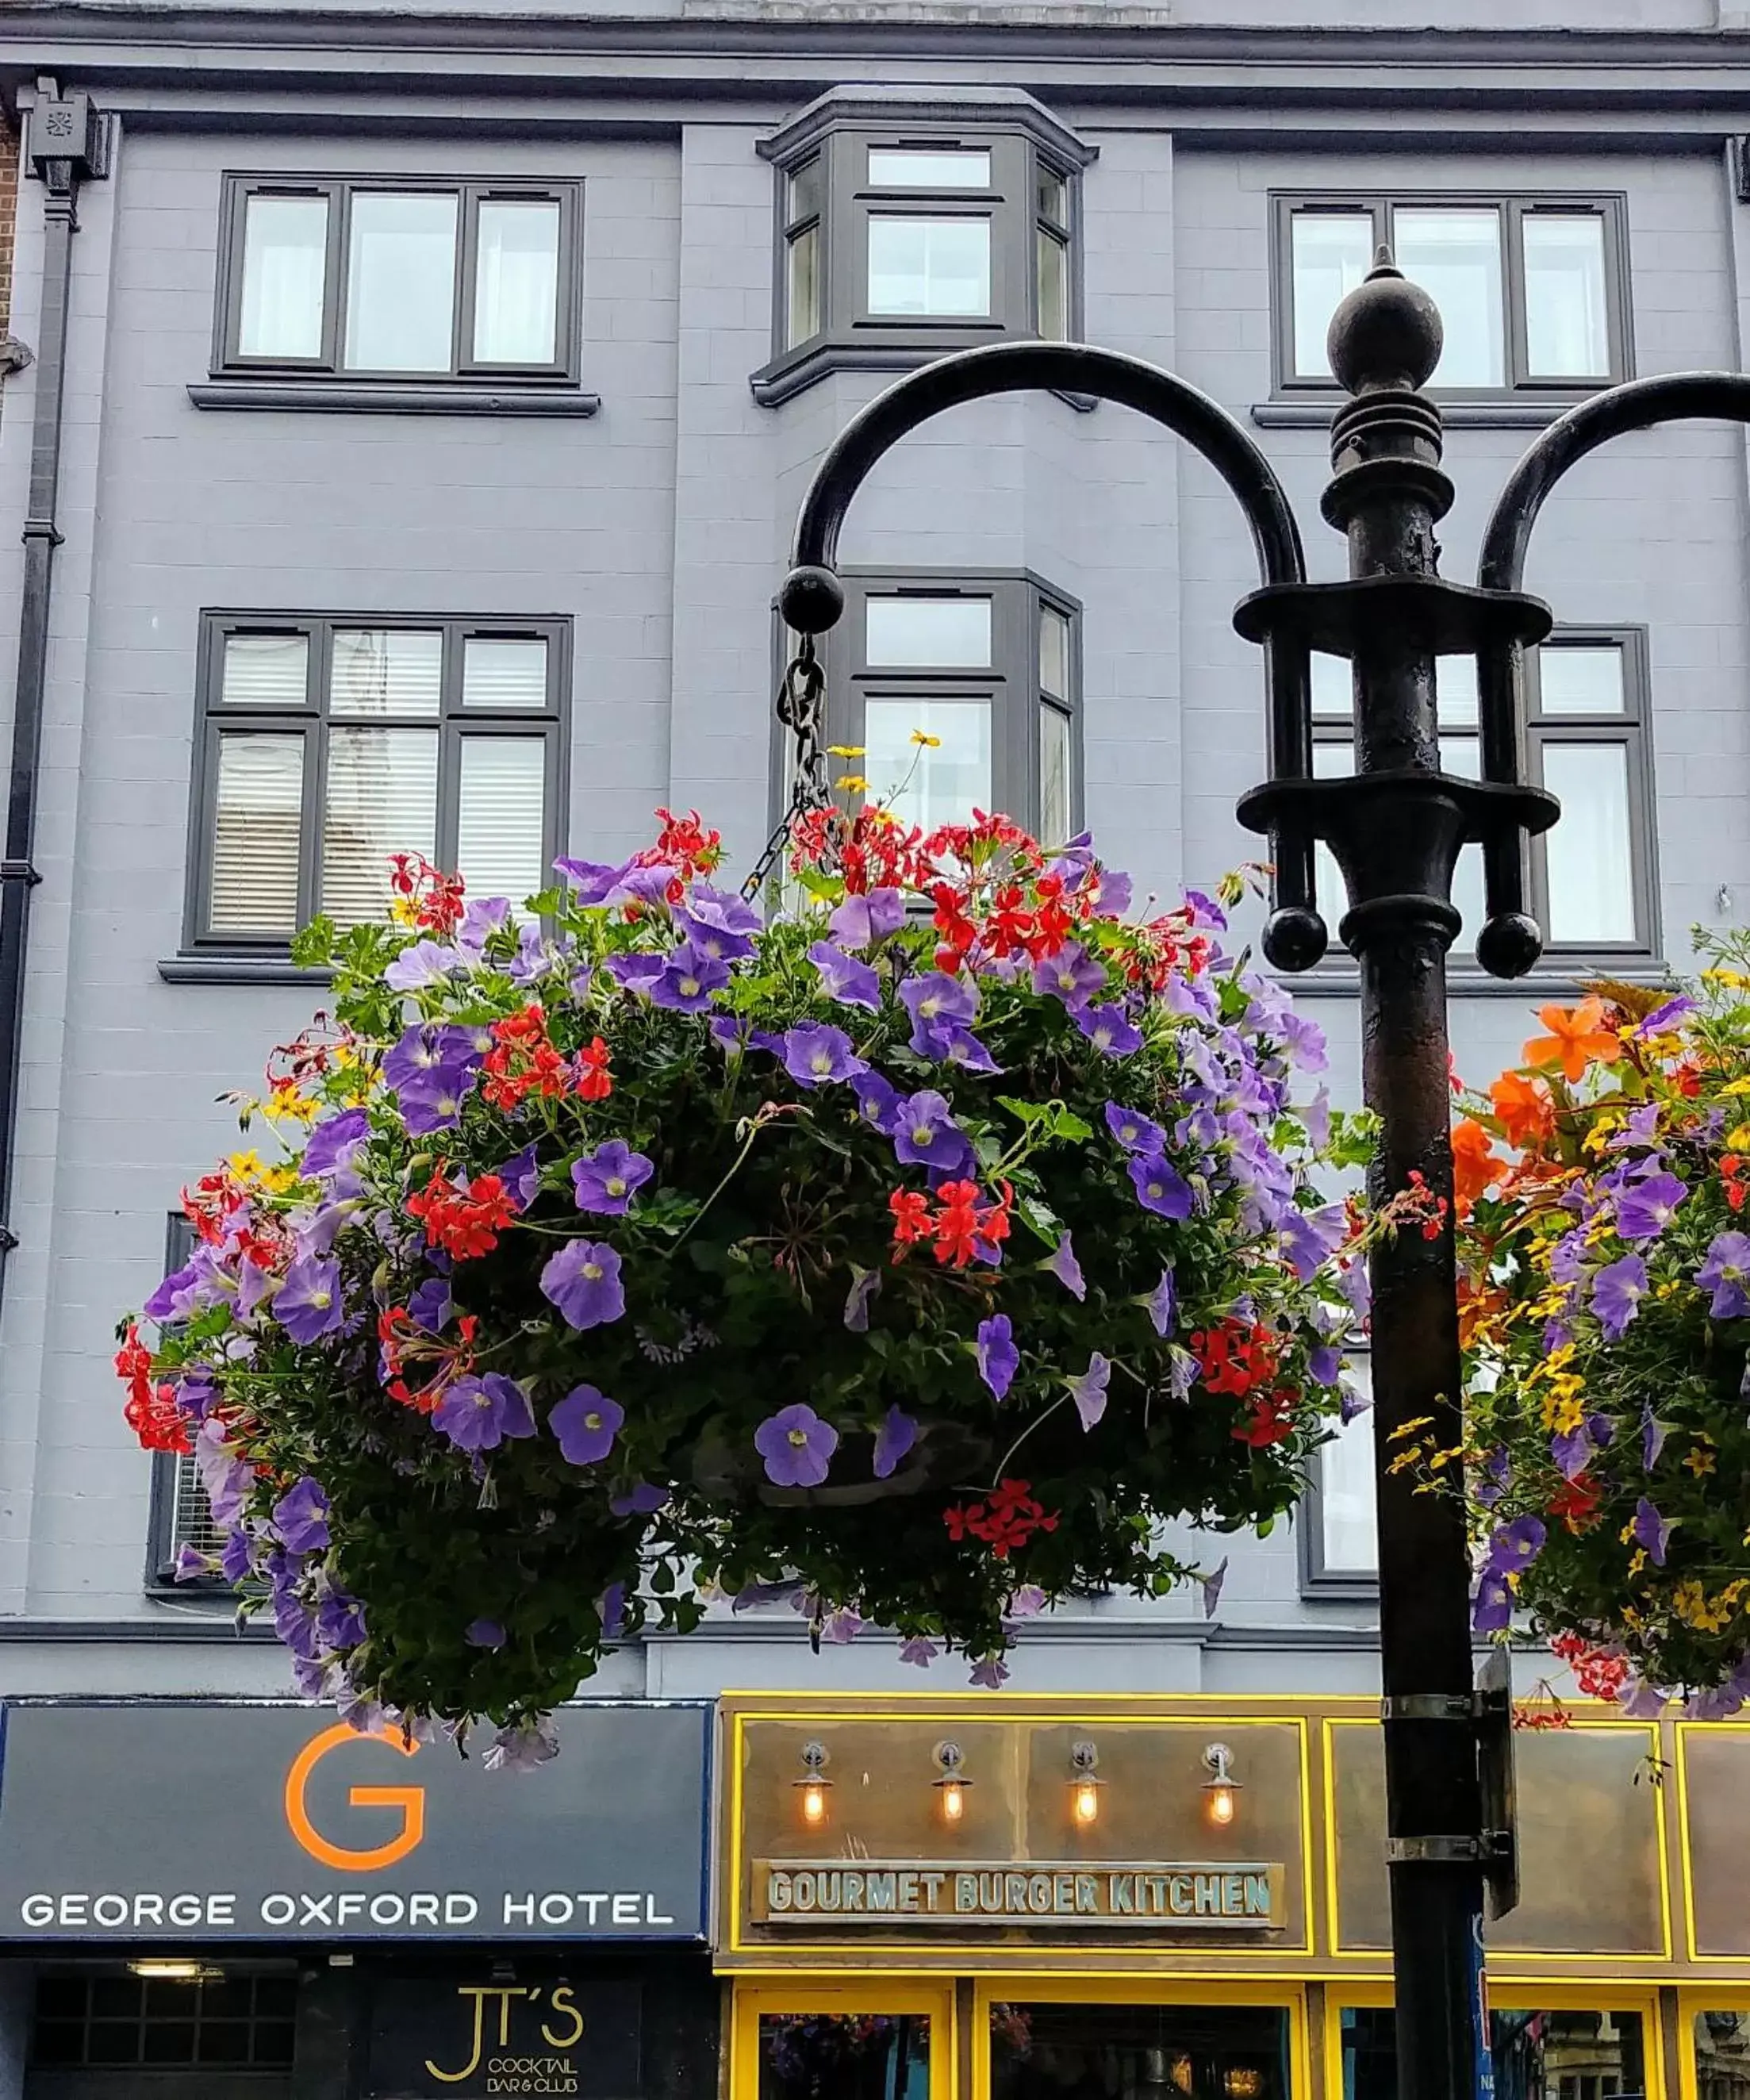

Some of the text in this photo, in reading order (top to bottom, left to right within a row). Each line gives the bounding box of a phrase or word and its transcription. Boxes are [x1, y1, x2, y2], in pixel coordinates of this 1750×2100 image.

[285, 1722, 425, 1872] G
[21, 1894, 674, 1926] GEORGE OXFORD HOTEL
[768, 1872, 1270, 1916] GOURMET BURGER KITCHEN
[424, 1987, 584, 2083] JT'S
[488, 2058, 578, 2077] COCKTAIL
